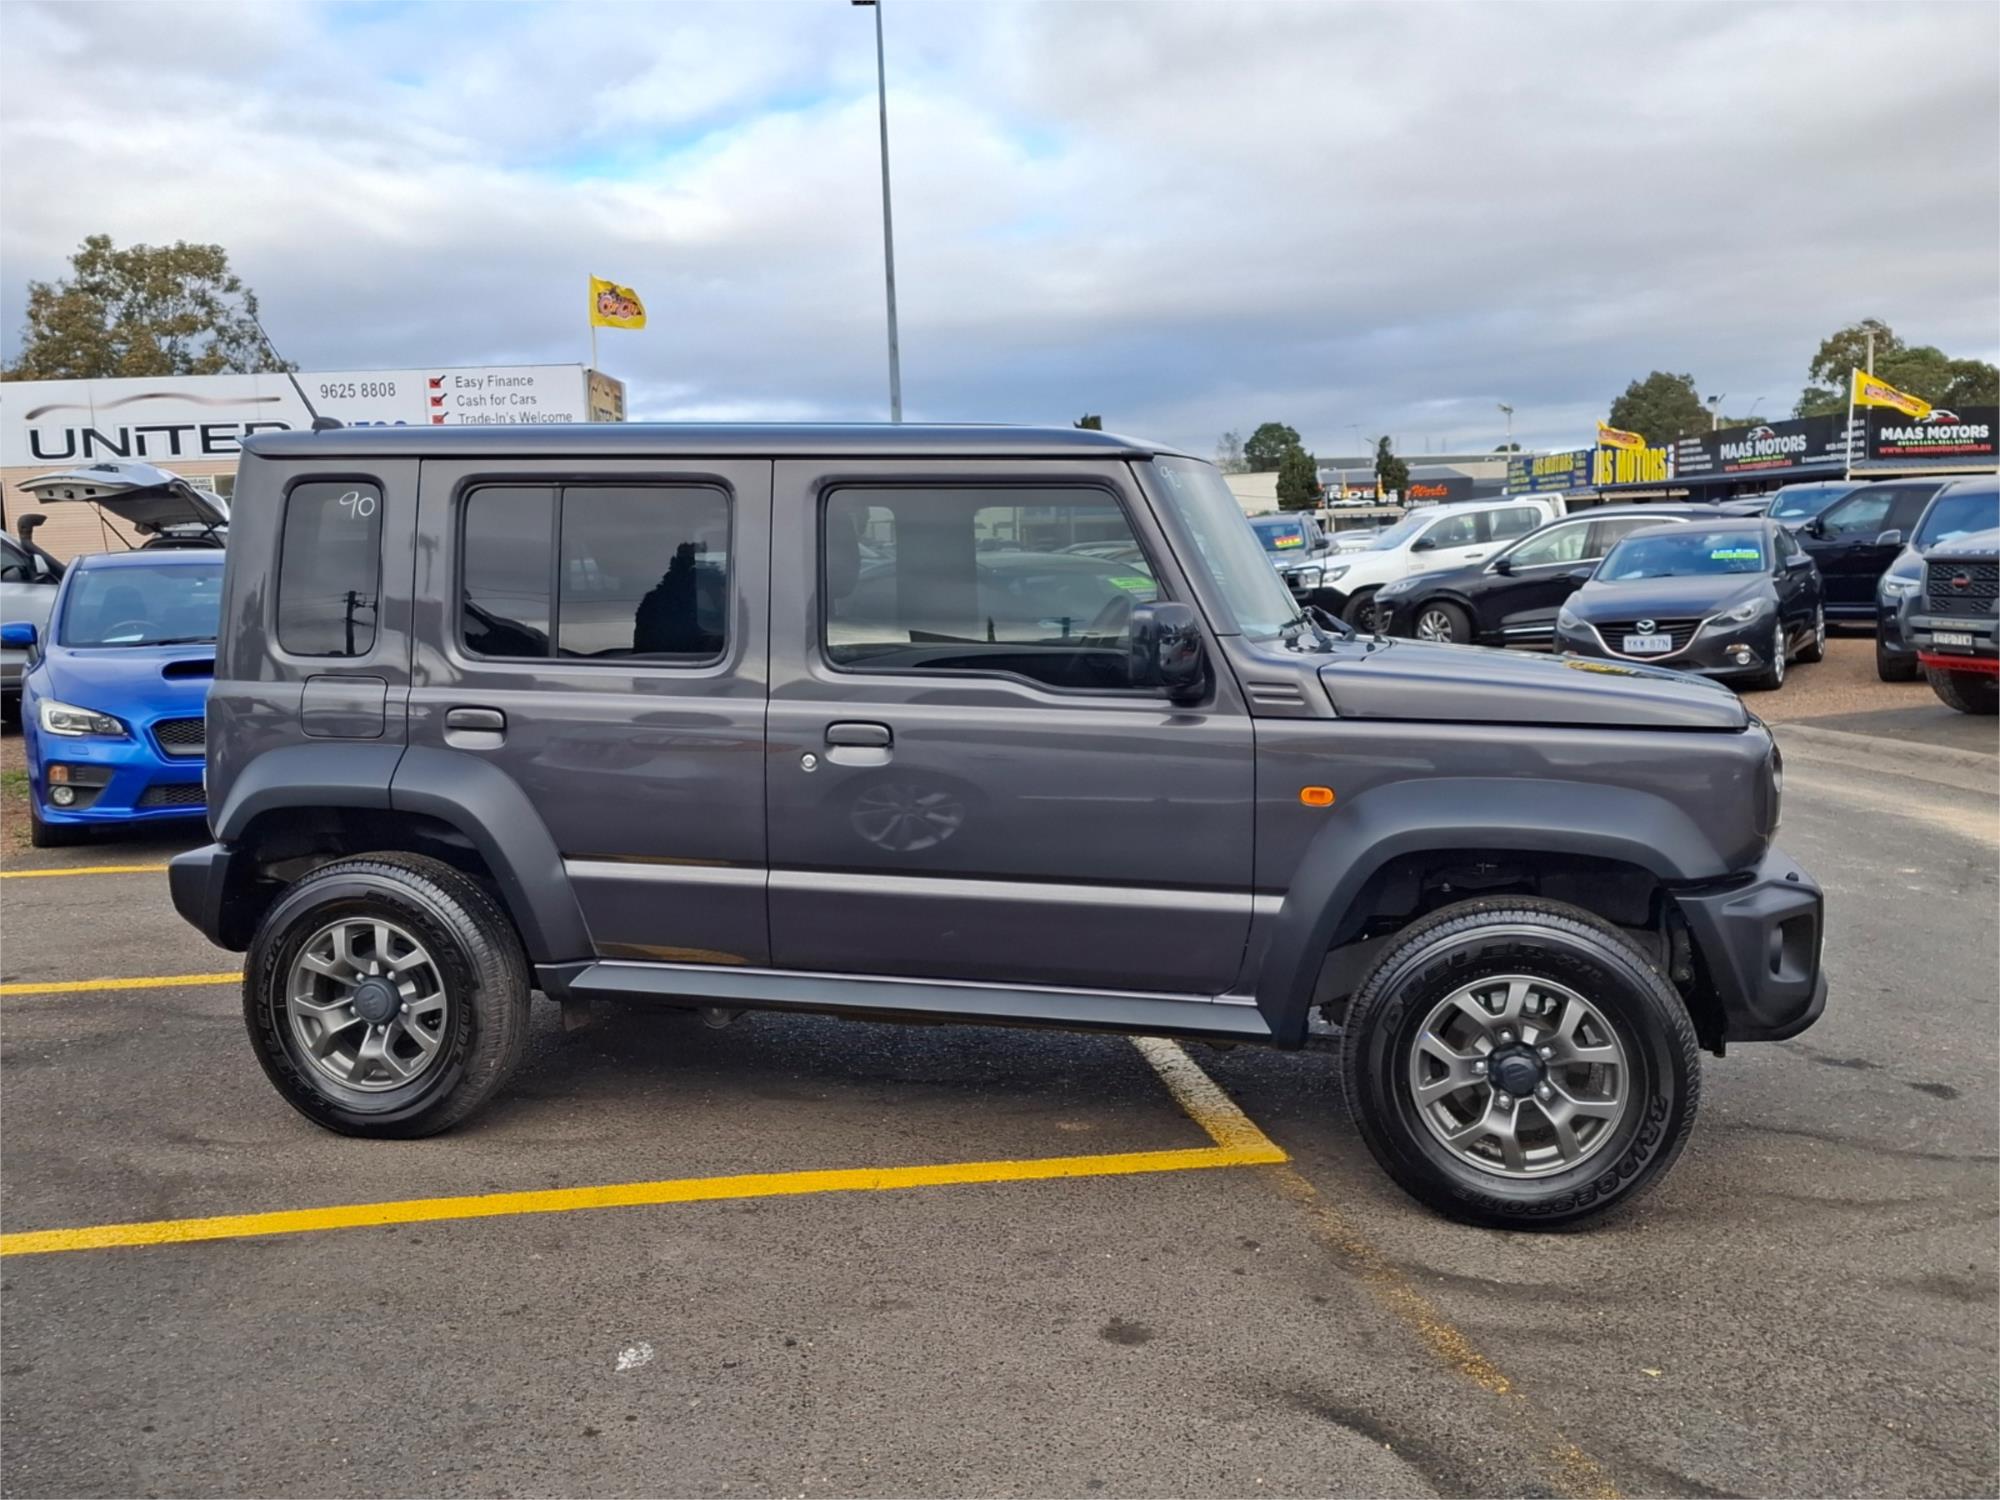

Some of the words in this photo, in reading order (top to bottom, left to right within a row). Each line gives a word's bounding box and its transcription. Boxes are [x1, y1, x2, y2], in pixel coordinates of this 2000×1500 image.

[320, 383, 356, 398] 9625
[361, 382, 396, 397] 8808
[455, 375, 484, 389] Easy
[487, 375, 534, 387] Finance
[456, 394, 487, 407] Cash
[489, 393, 507, 405] for
[510, 393, 537, 405] Cars
[458, 412, 515, 424] Trade-In's
[519, 411, 573, 423] Welcome
[1880, 427, 1924, 440] MAAS
[1927, 424, 1989, 439] MOTORS
[1720, 440, 1753, 460] MAAS
[1755, 434, 1807, 455] MOTORS
[1615, 447, 1667, 484] MOTORS
[339, 490, 376, 519] 90
